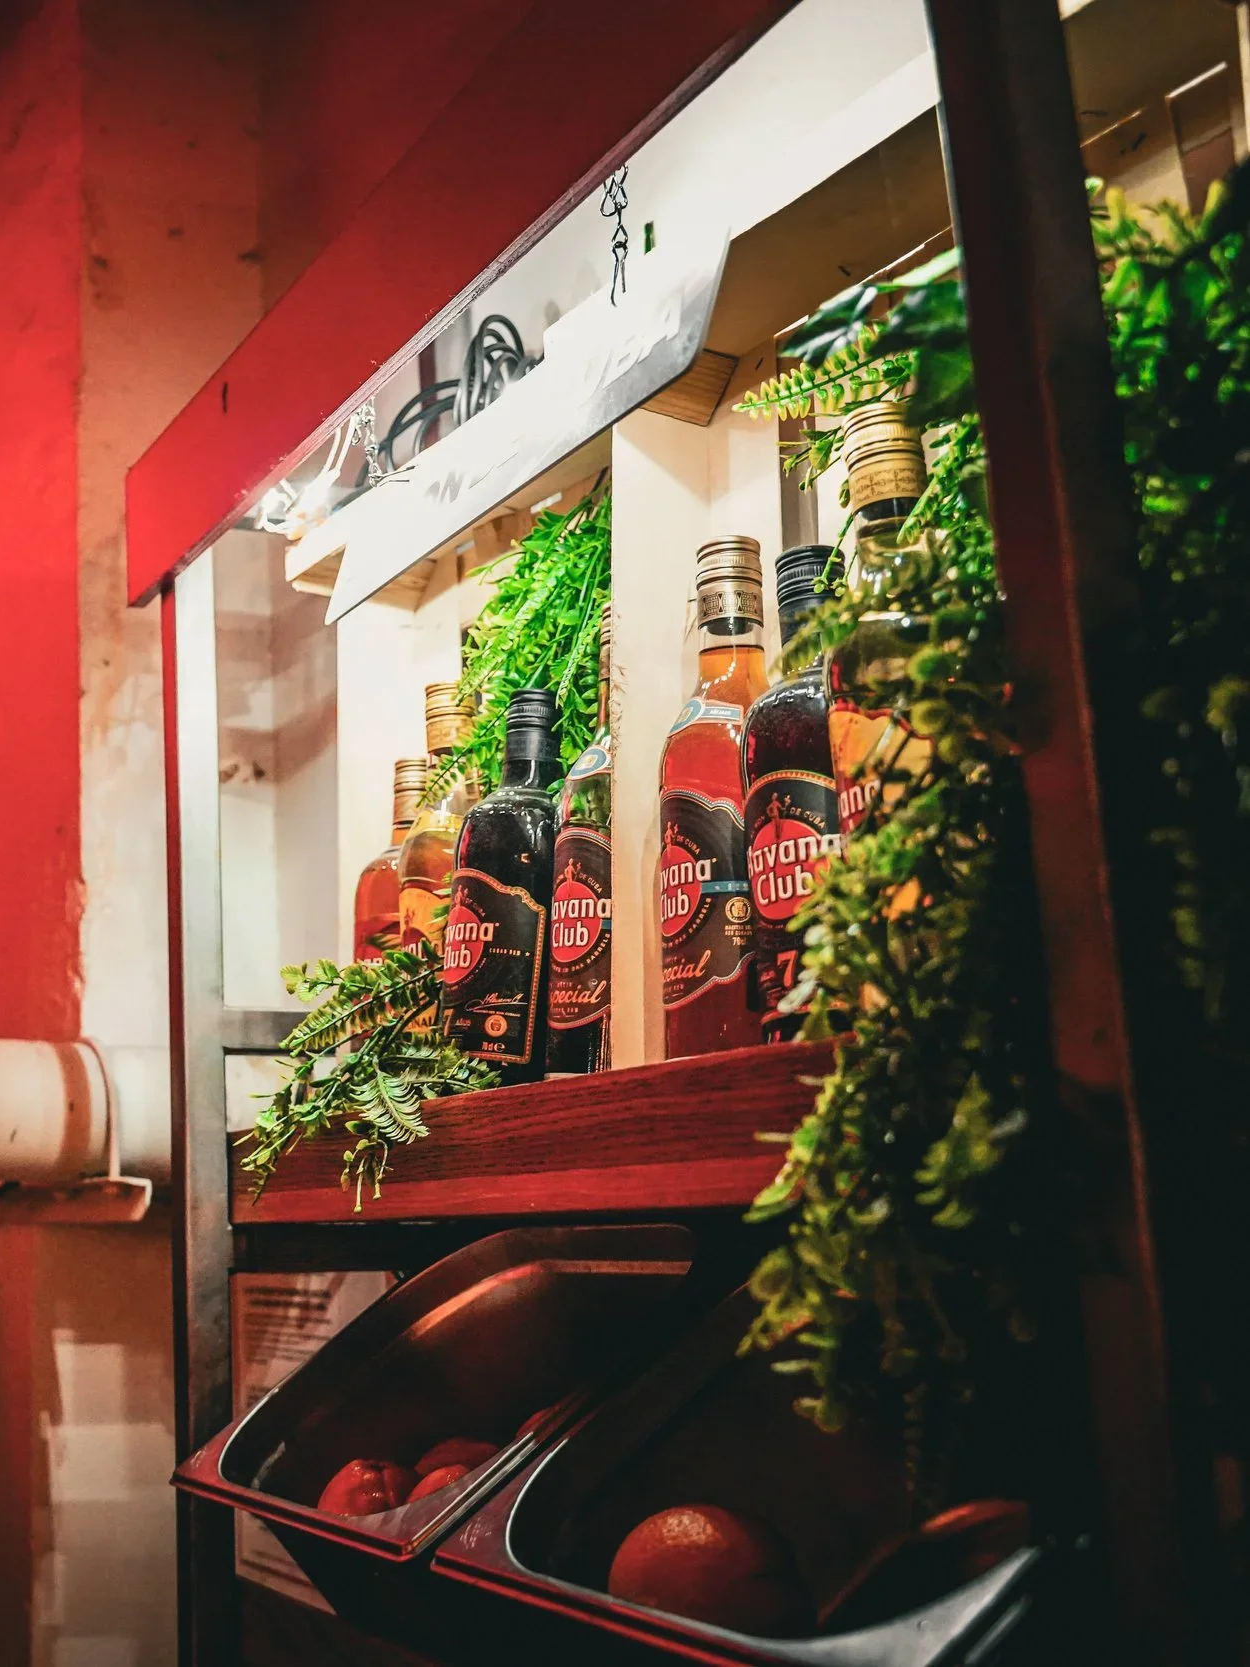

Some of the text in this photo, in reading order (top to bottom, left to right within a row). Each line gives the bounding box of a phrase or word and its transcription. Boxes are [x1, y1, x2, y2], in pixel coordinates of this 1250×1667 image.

[803, 810, 827, 829] CUBA
[685, 838, 701, 855] CUBA
[587, 877, 603, 894] CUBA
[661, 859, 712, 893] vana
[757, 865, 815, 906] Club
[551, 897, 612, 922] avana
[445, 922, 495, 944] vana
[552, 920, 589, 949] Club
[777, 950, 798, 987] 7
[443, 1008, 454, 1037] 7
